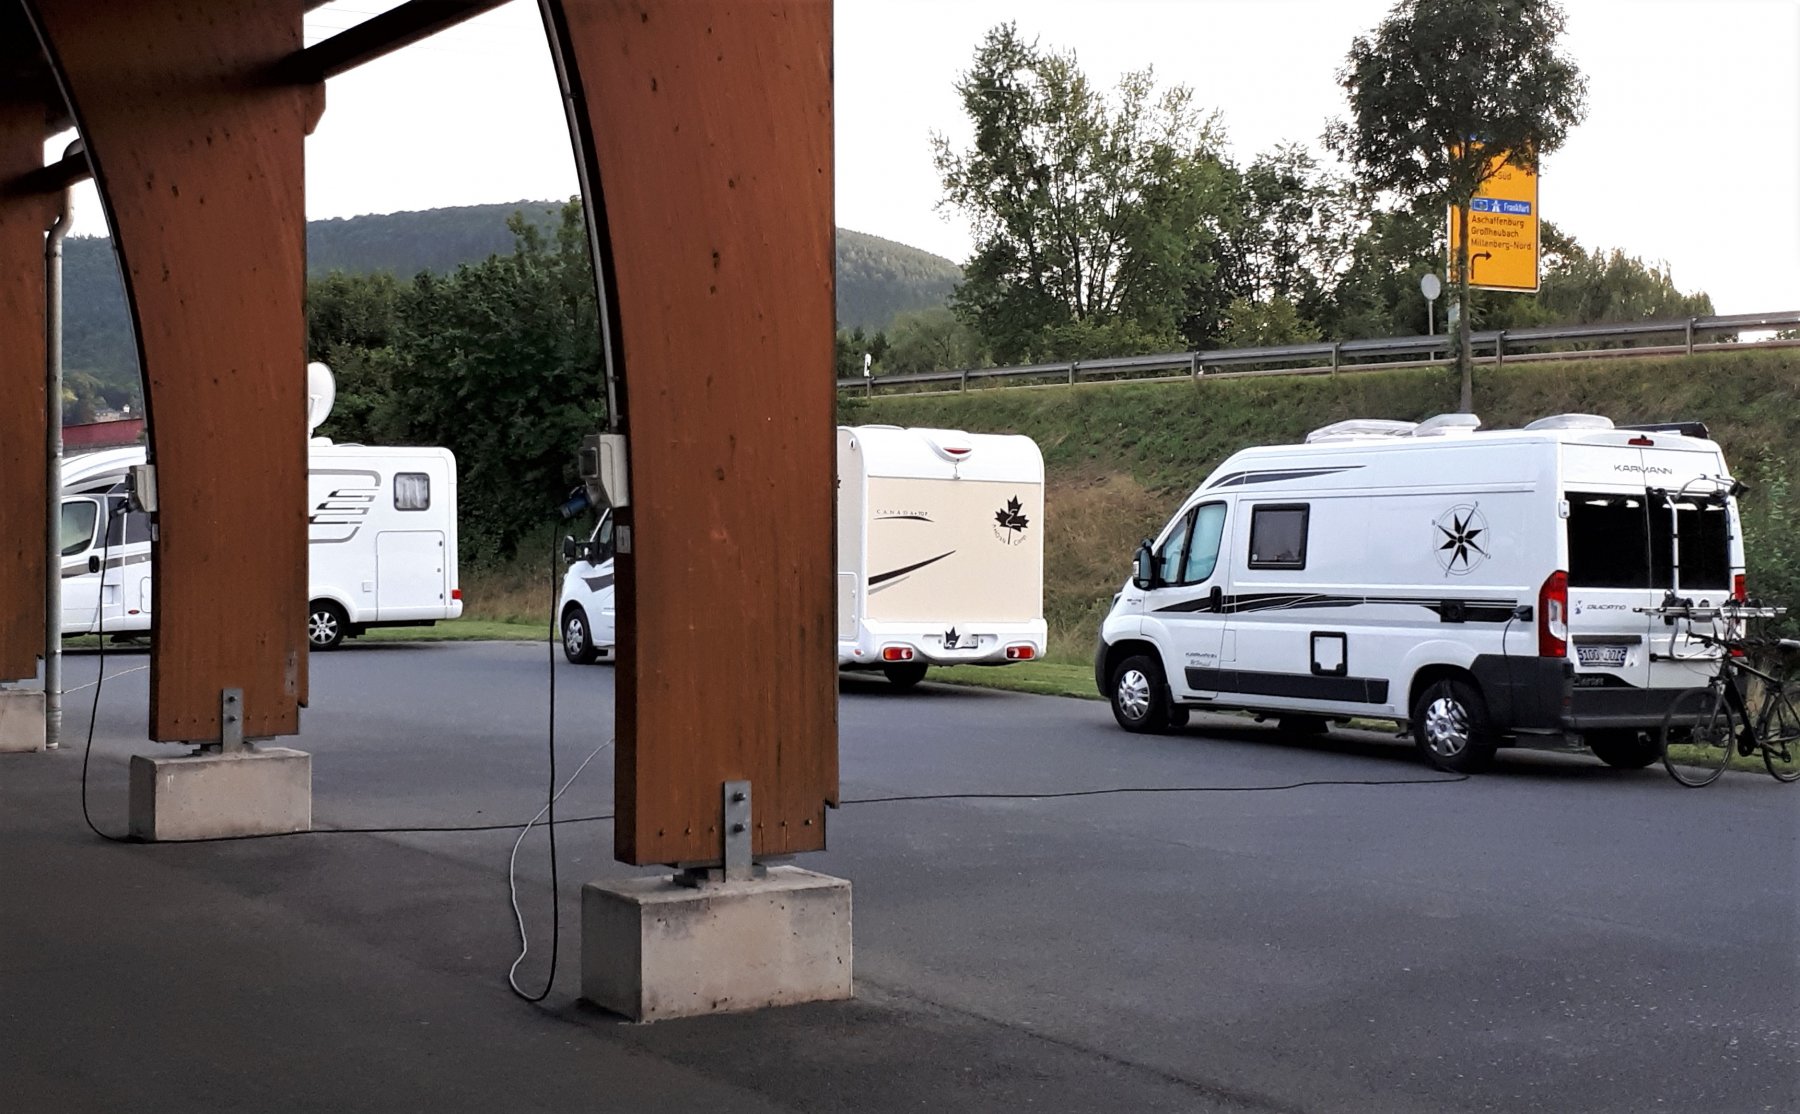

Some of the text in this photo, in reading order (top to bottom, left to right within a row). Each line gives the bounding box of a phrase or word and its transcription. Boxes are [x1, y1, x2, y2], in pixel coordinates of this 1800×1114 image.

[1503, 202, 1530, 214] Frankfurt
[1471, 215, 1525, 229] Aschaffenburg
[1613, 464, 1673, 475] KARMANN
